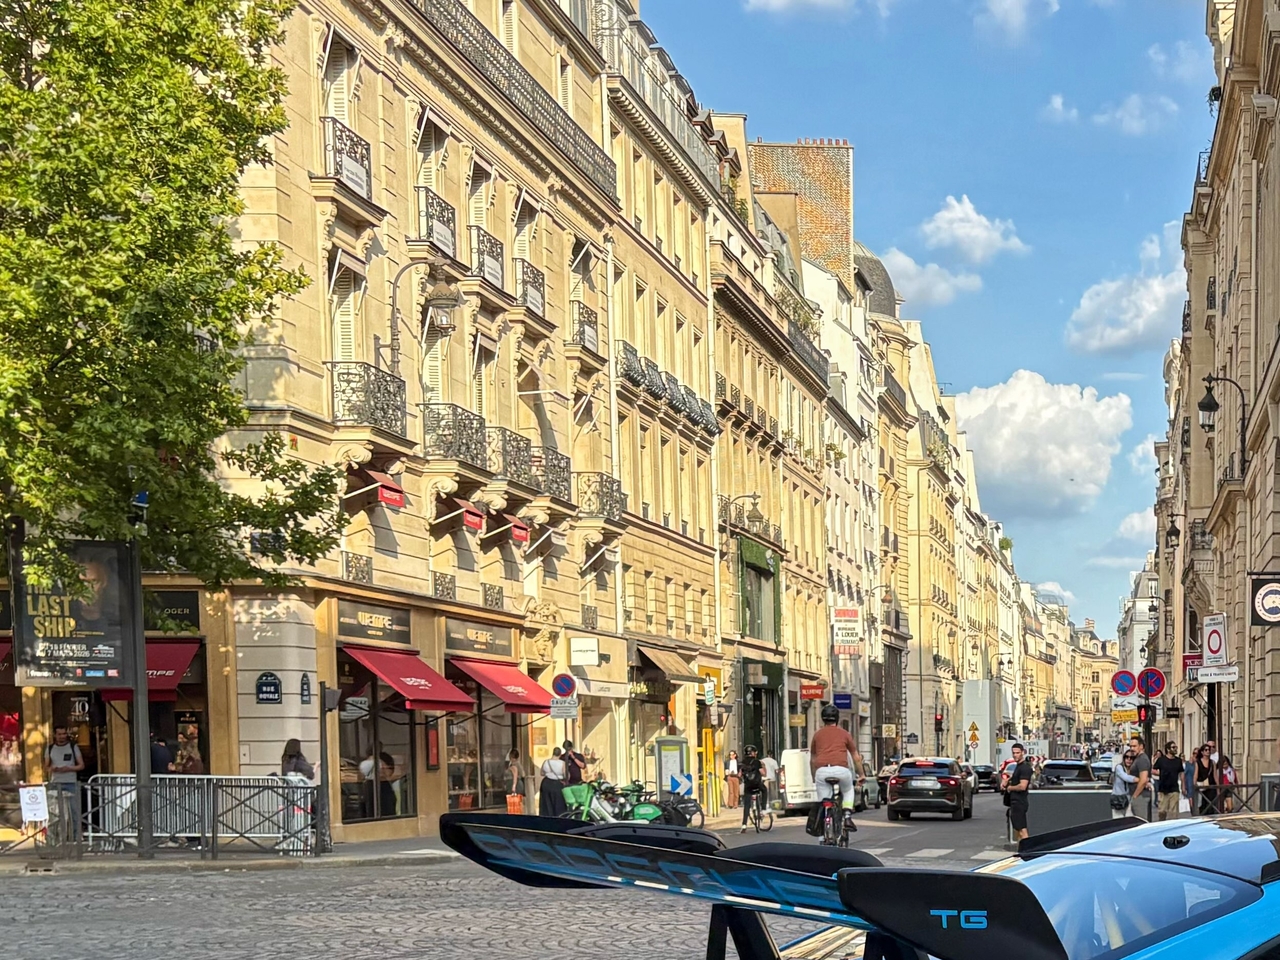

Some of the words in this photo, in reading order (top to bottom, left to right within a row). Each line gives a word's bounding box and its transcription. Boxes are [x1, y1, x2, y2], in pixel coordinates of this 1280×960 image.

[27, 595, 71, 616] LAST
[33, 616, 76, 638] SHIP
[929, 909, 988, 929] TG
